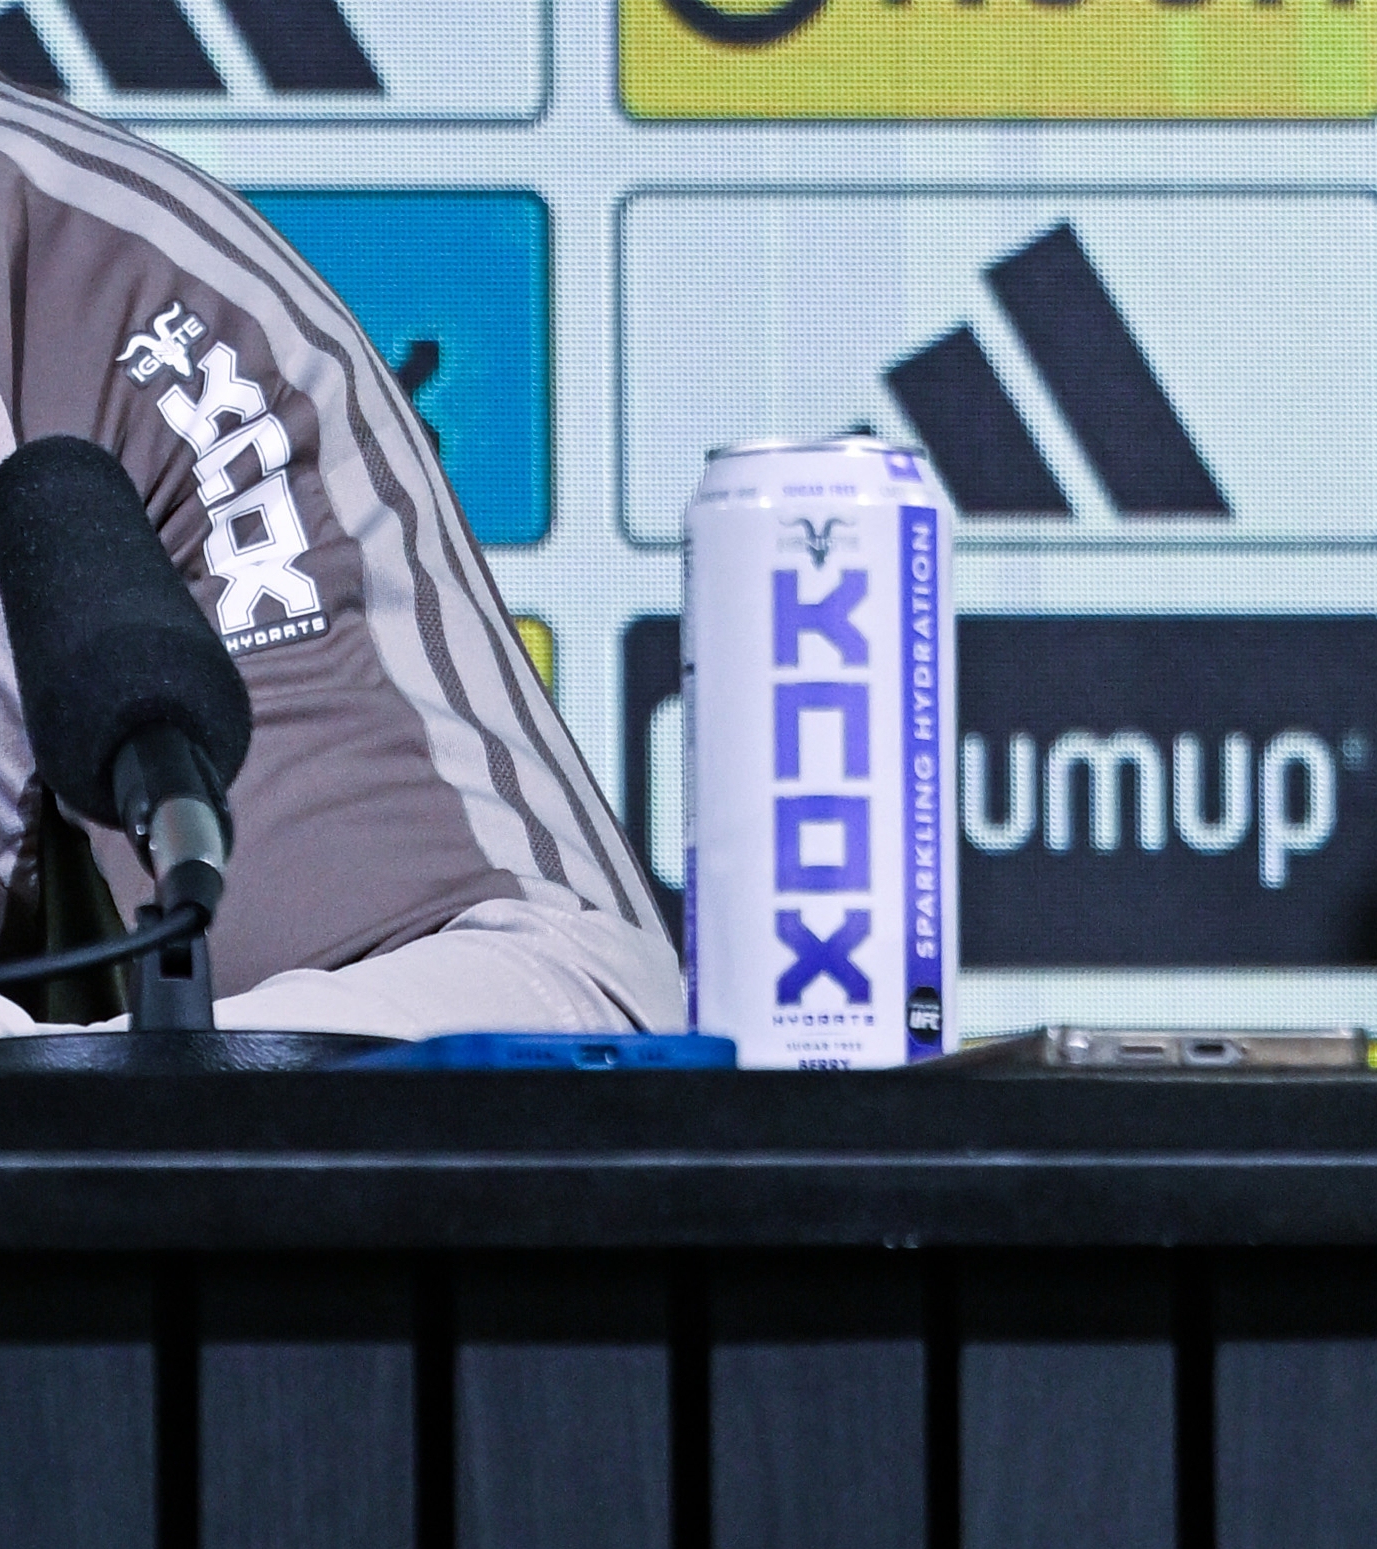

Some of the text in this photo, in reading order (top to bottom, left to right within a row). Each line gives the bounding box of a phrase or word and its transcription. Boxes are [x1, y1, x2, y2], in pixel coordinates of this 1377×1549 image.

[225, 615, 327, 653] HYDRATE
[911, 522, 938, 960] SPARKLING HYDRATION
[959, 729, 1337, 890] umup
